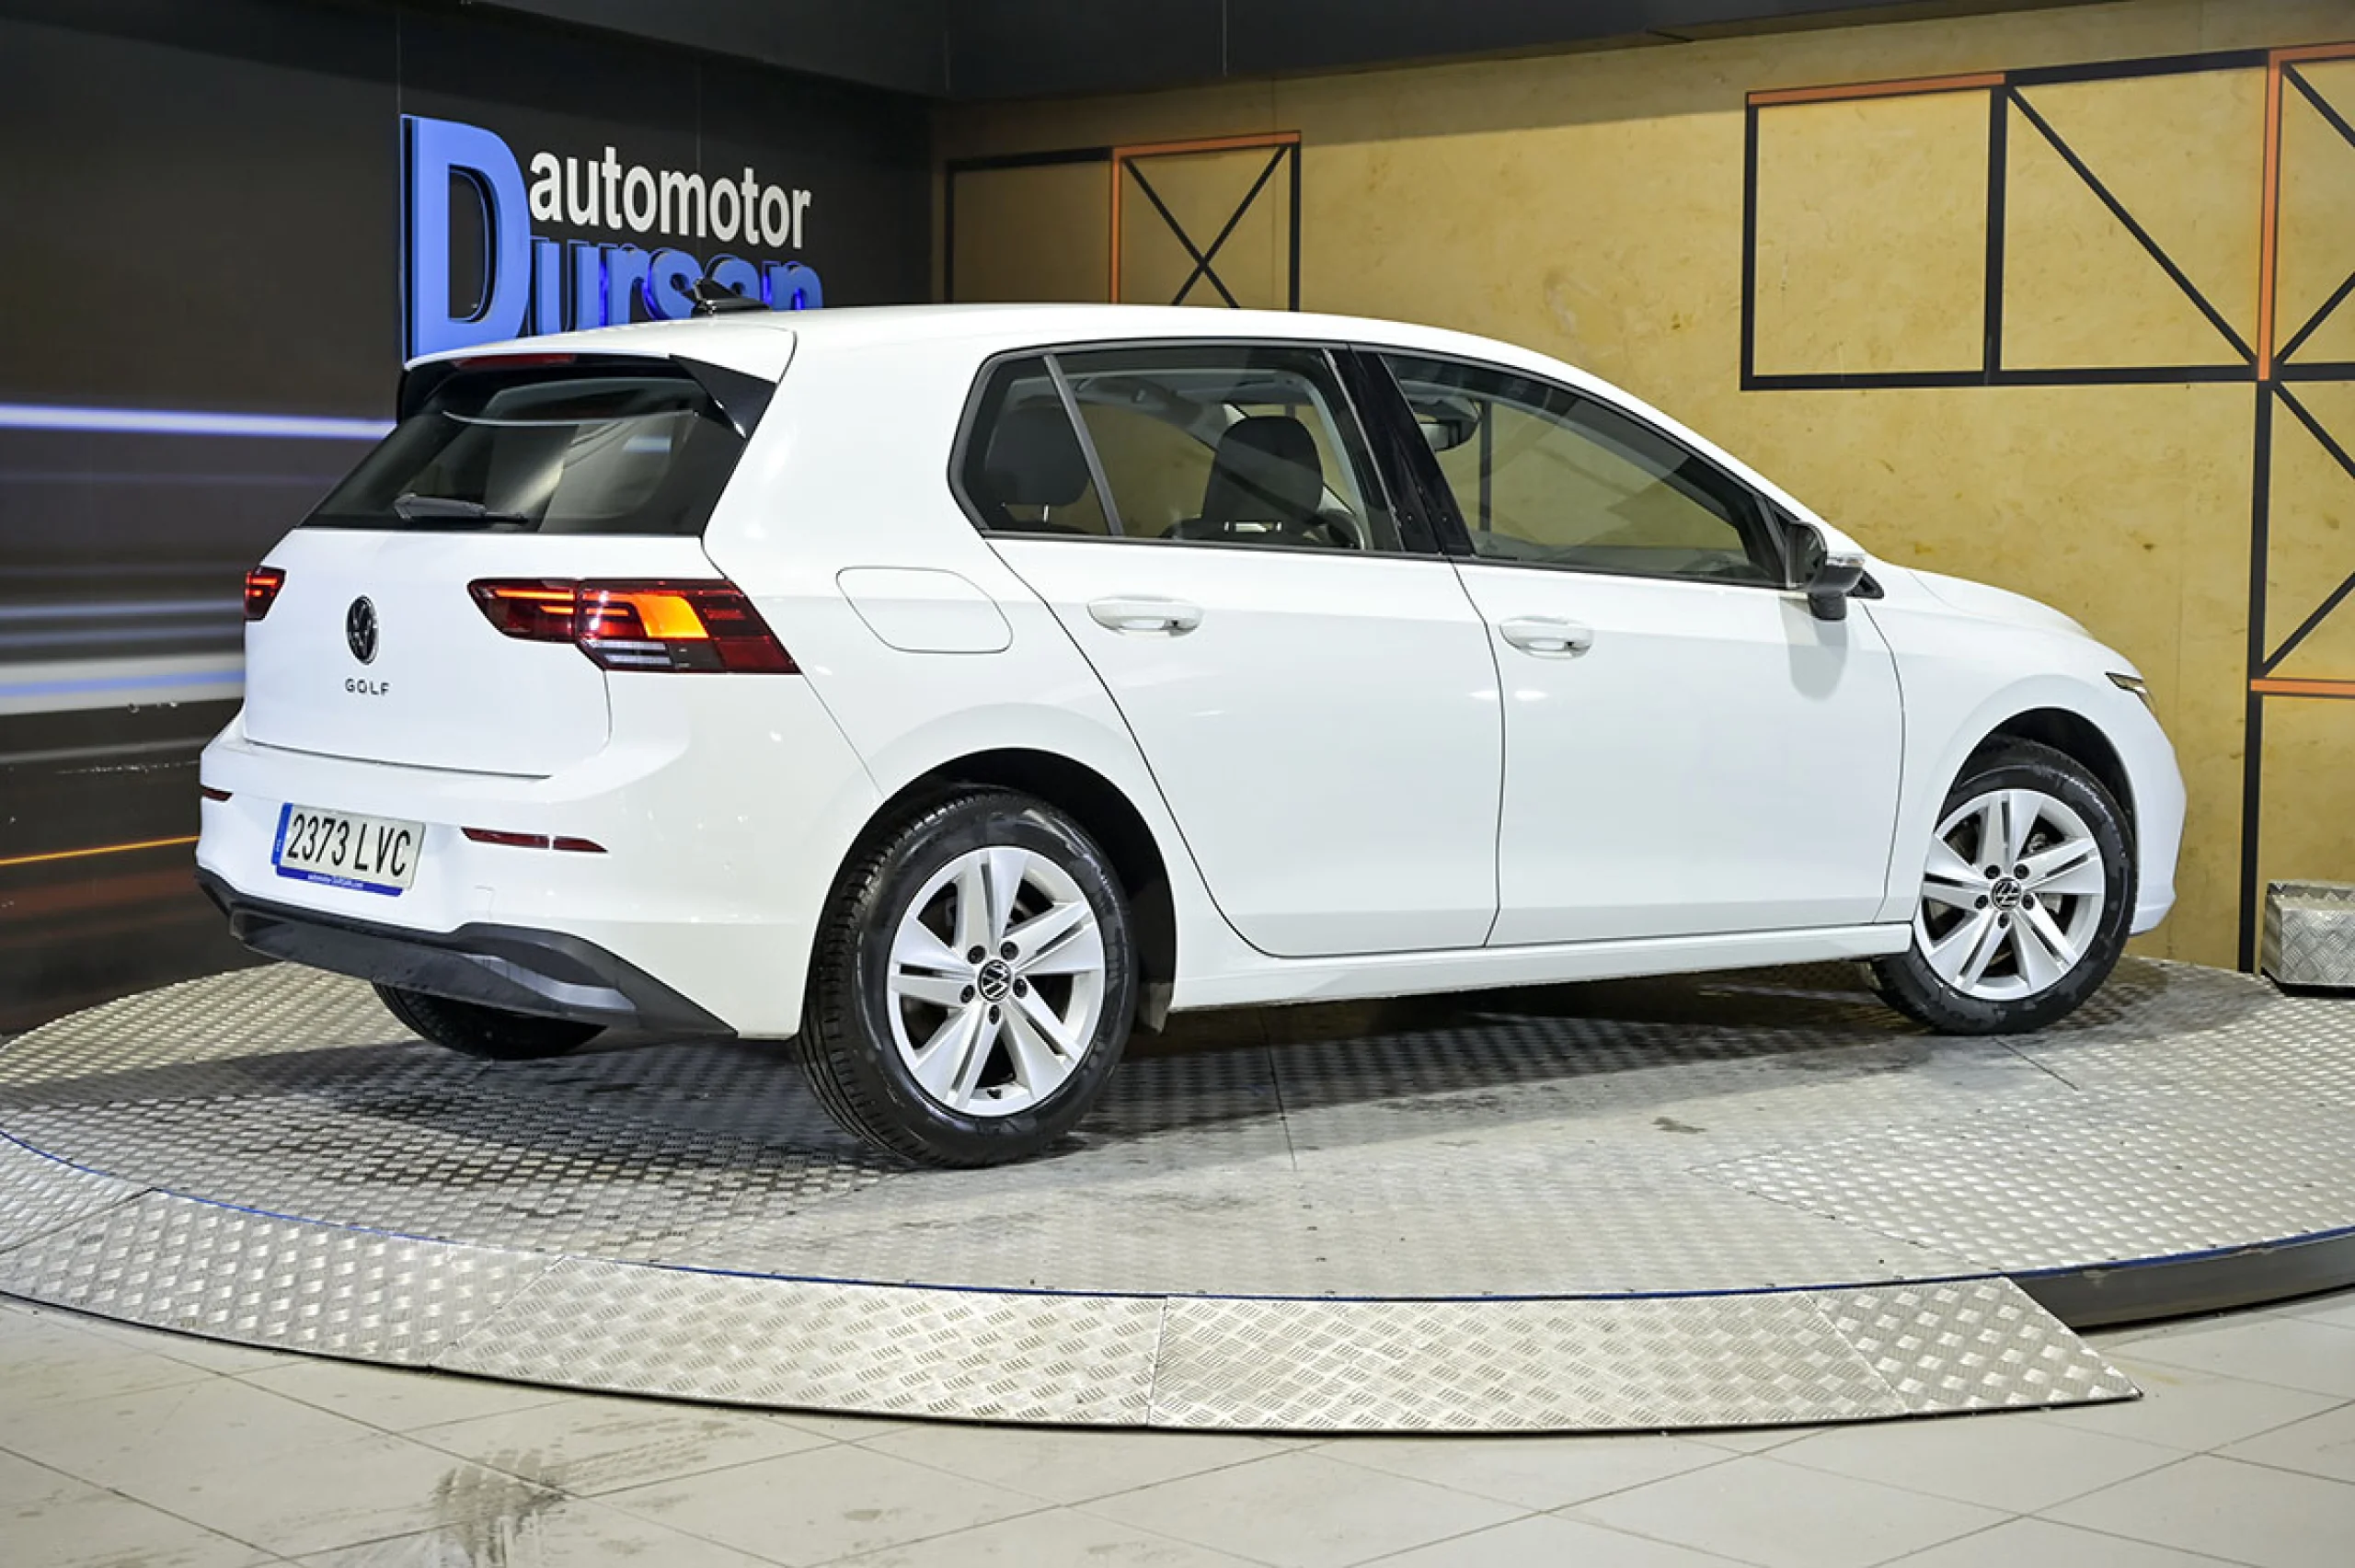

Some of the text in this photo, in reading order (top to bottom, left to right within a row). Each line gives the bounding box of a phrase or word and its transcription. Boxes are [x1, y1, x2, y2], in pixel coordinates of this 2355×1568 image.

[529, 145, 811, 249] automotor
[344, 678, 390, 696] GOLF
[286, 813, 411, 876] 2373 LVC
